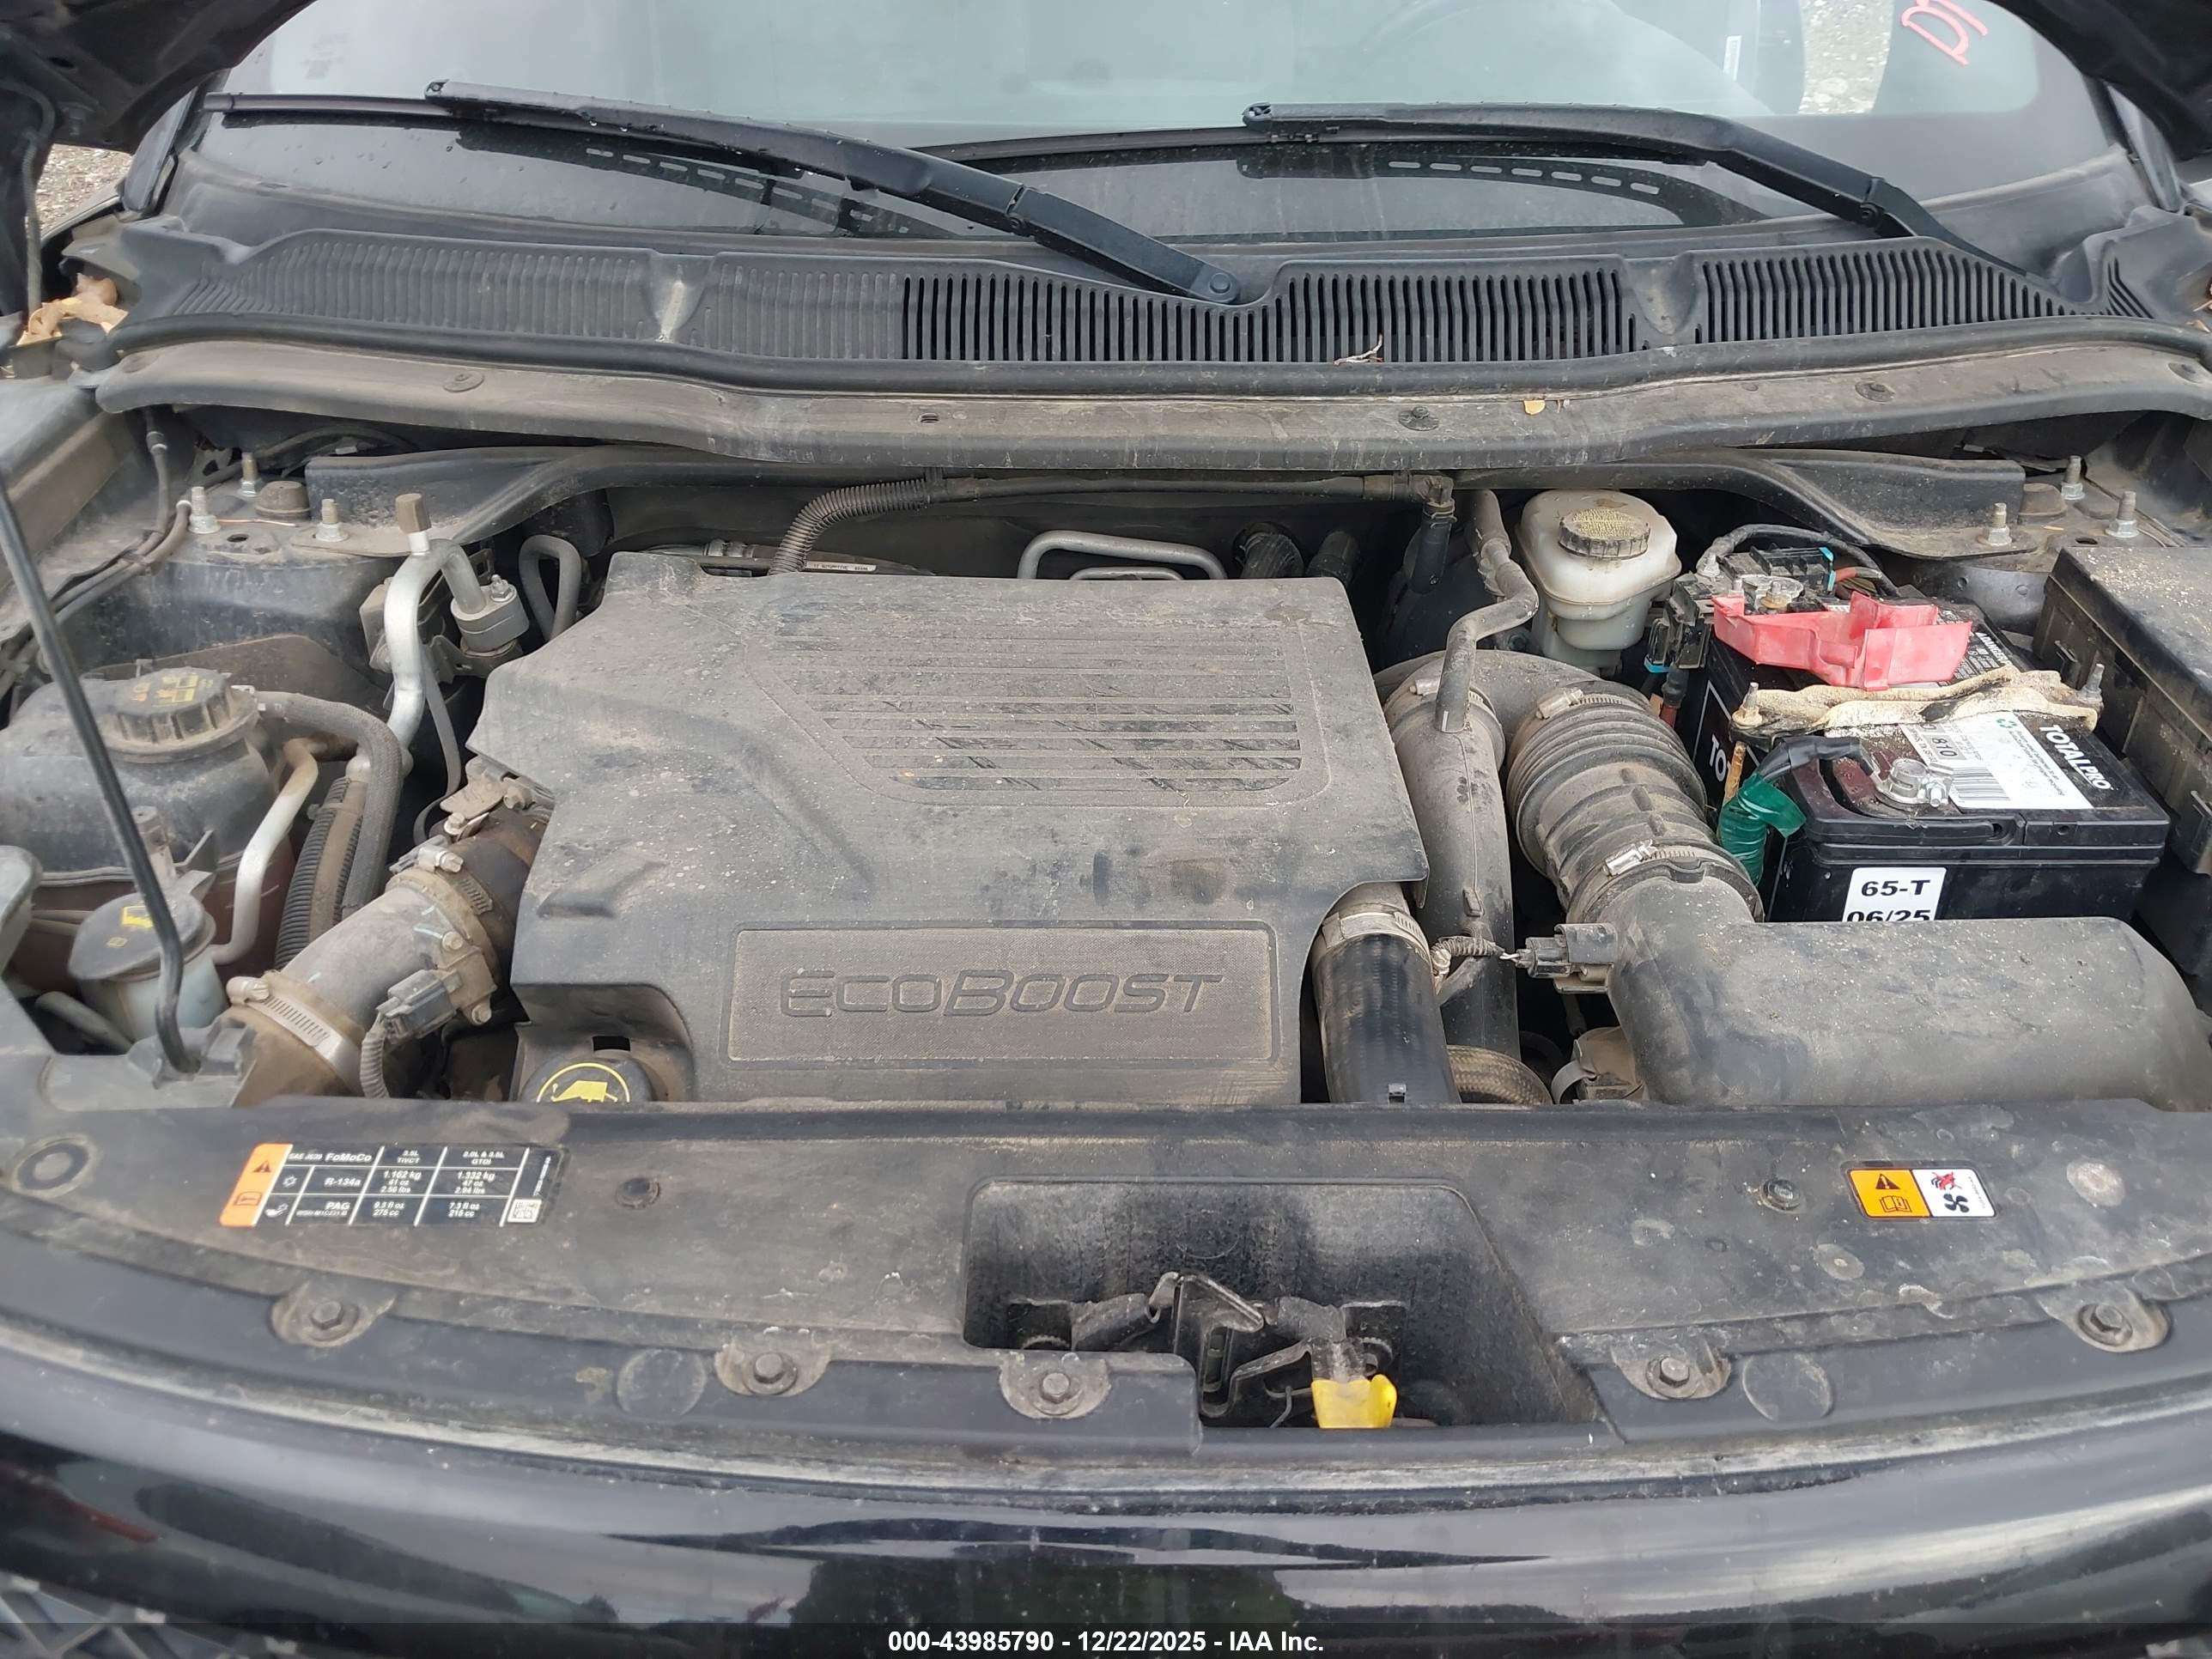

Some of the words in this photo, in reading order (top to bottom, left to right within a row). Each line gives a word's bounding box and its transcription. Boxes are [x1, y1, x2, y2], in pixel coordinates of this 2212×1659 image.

[1709, 734, 1732, 782] TO
[2039, 724, 2112, 790] TOTALPRO
[1861, 879, 1931, 897] 65-T
[325, 1152, 372, 1163] FoMoCo
[409, 1170, 422, 1181] kg
[483, 1171, 495, 1182] kg
[324, 1177, 362, 1187] R-134a
[325, 1201, 351, 1210] PAG
